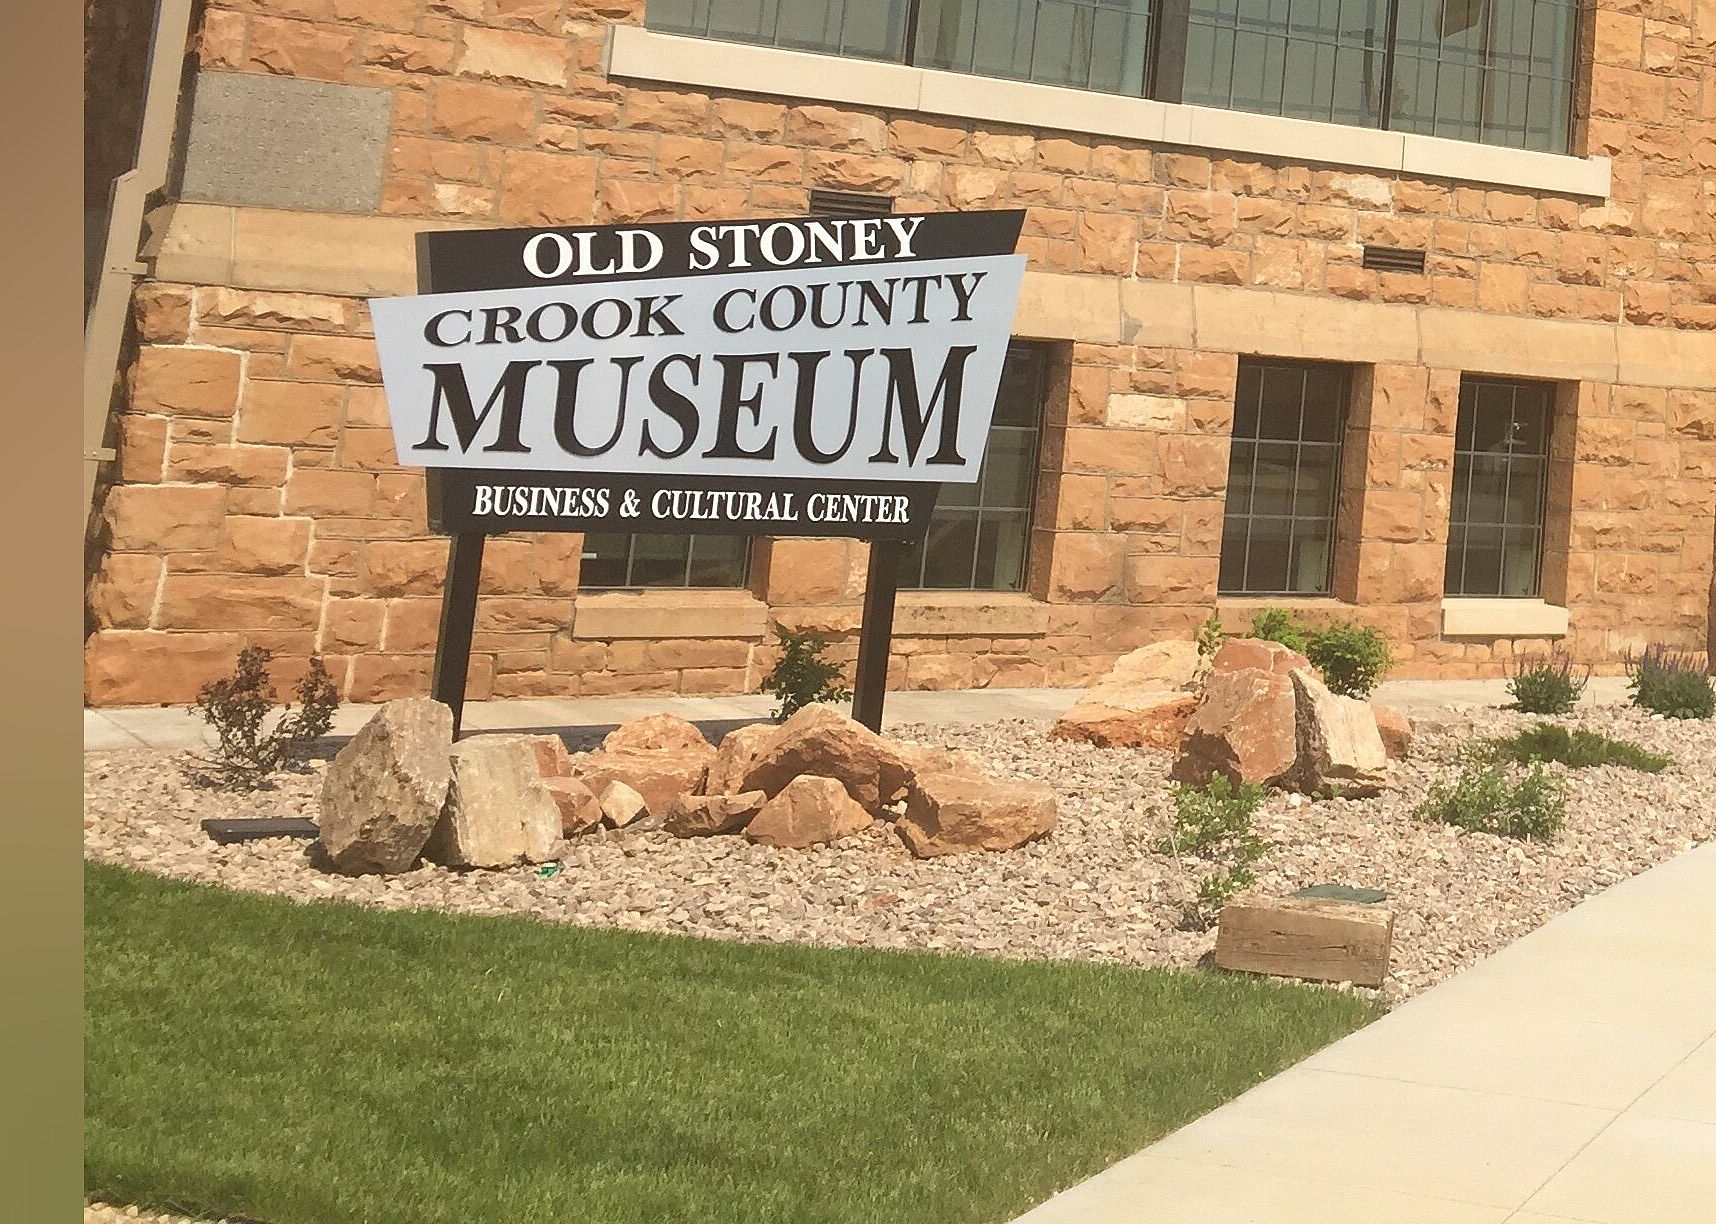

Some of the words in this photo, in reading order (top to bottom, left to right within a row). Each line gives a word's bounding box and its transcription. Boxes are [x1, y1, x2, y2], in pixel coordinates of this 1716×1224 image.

[522, 230, 665, 278] OLD
[688, 216, 924, 270] STONEY
[423, 294, 685, 347] CROOK
[713, 272, 988, 333] COUNTY
[411, 344, 978, 467] MUSEUM
[473, 485, 610, 518] BUSINESS
[619, 495, 641, 518] &
[651, 489, 799, 521] CULTURAL
[806, 493, 911, 523] CENTER
